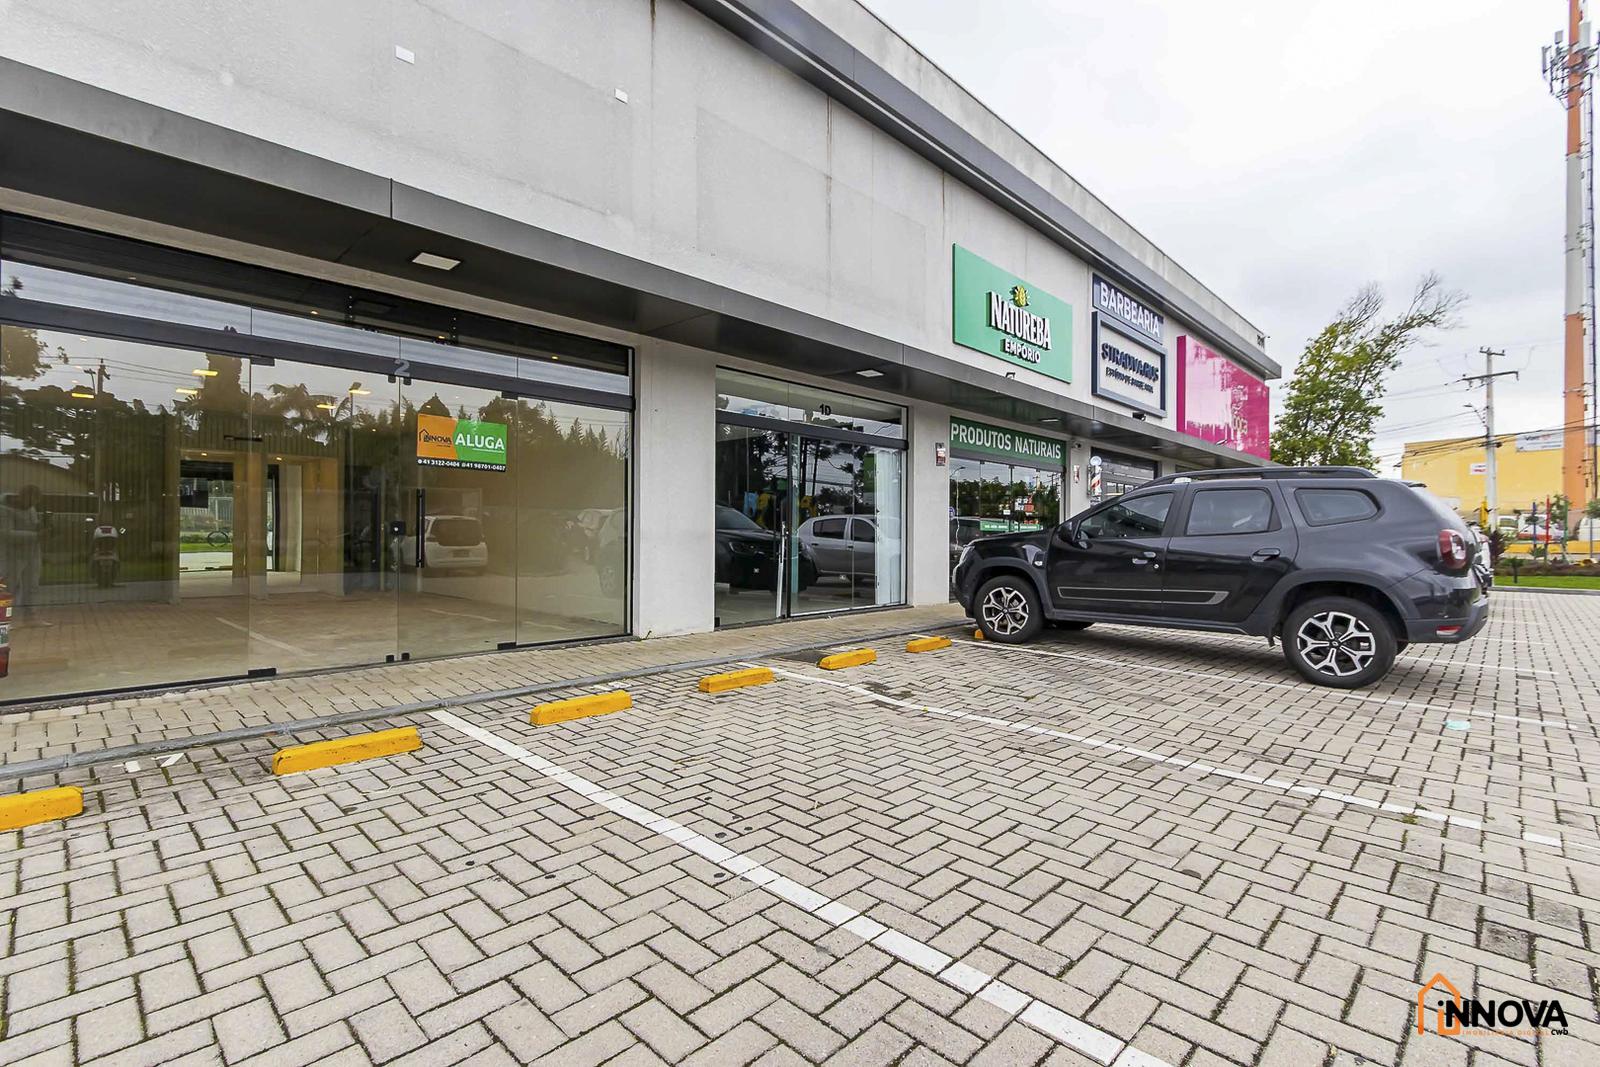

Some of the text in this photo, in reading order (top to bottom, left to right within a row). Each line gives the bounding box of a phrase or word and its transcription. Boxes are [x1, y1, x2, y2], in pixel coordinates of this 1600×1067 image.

[990, 291, 1052, 350] NATUREBA
[1100, 281, 1160, 338] BARBEARIA
[1004, 339, 1041, 363] EMPÓRIO
[394, 359, 410, 377] 2
[819, 403, 831, 416] 1D
[455, 433, 504, 450] ALUGA
[951, 423, 1062, 460] PRODUTOS NATURAIS
